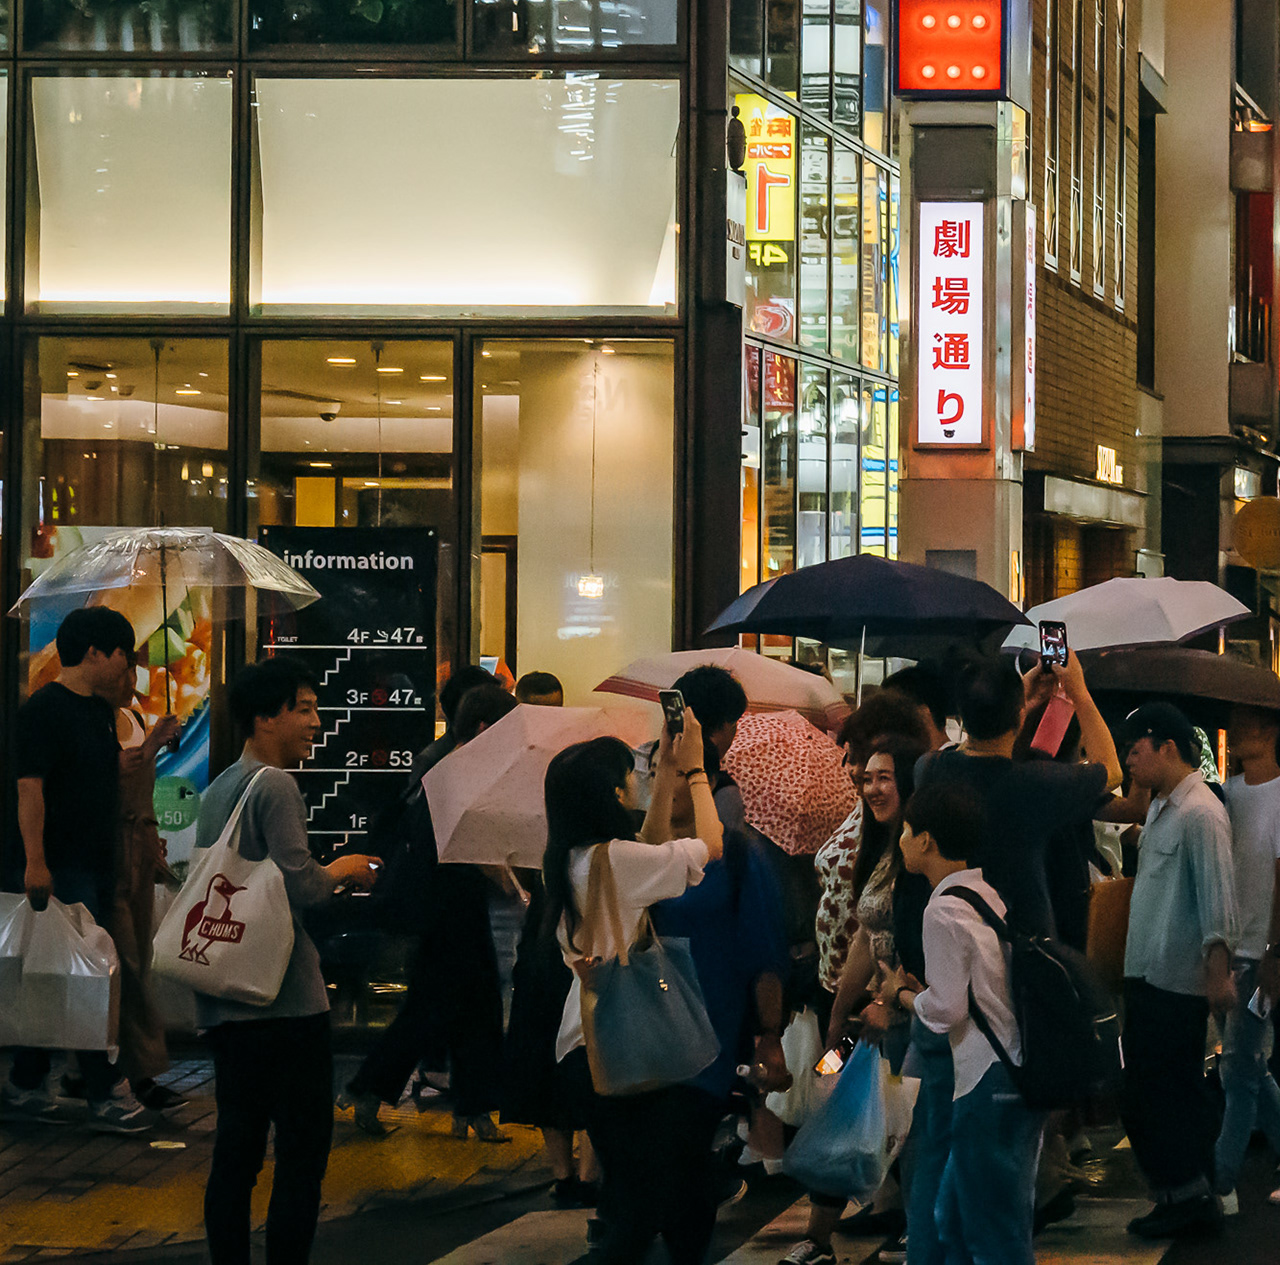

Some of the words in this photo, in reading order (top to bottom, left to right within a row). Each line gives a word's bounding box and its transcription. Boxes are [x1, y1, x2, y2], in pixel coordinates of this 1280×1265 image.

[931, 219, 972, 427] 劇場通り
[283, 549, 414, 570] information
[346, 628, 370, 644] 4F
[346, 689, 369, 705] 3F
[345, 751, 369, 767] 2F
[388, 750, 414, 767] 53
[348, 813, 368, 829] 1F
[200, 918, 242, 941] CHUMS
